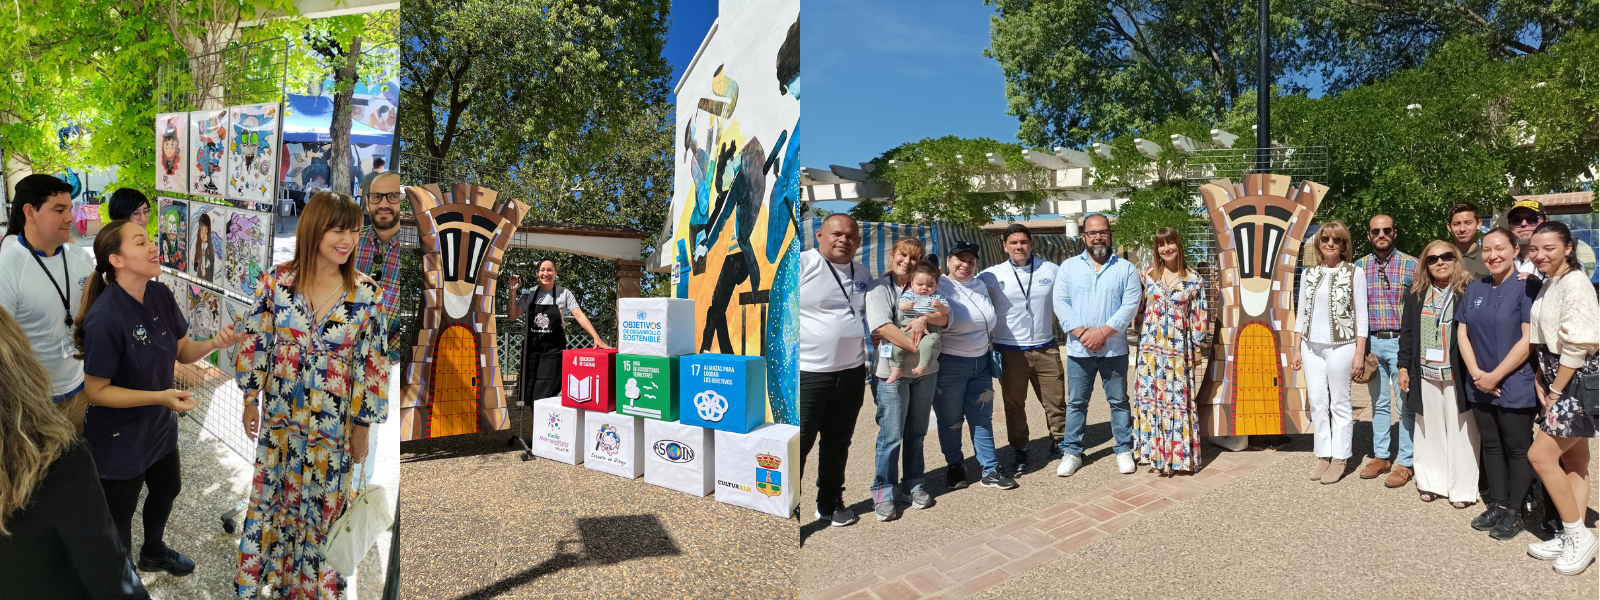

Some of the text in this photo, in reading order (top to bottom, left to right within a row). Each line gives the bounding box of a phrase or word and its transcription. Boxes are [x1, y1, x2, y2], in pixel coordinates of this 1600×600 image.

[622, 320, 662, 330] OBJETIVOS
[622, 333, 661, 343] SOSTENIBLE
[572, 356, 577, 366] 4
[623, 360, 631, 371] 15
[691, 363, 701, 377] 17
[703, 364, 722, 372] ALIANZAS
[703, 370, 719, 378] LOGRAR
[711, 377, 733, 386] OBJETIVOS
[539, 435, 569, 447] Metropolitana
[547, 432, 561, 440] Radio
[590, 452, 606, 461] Escuela
